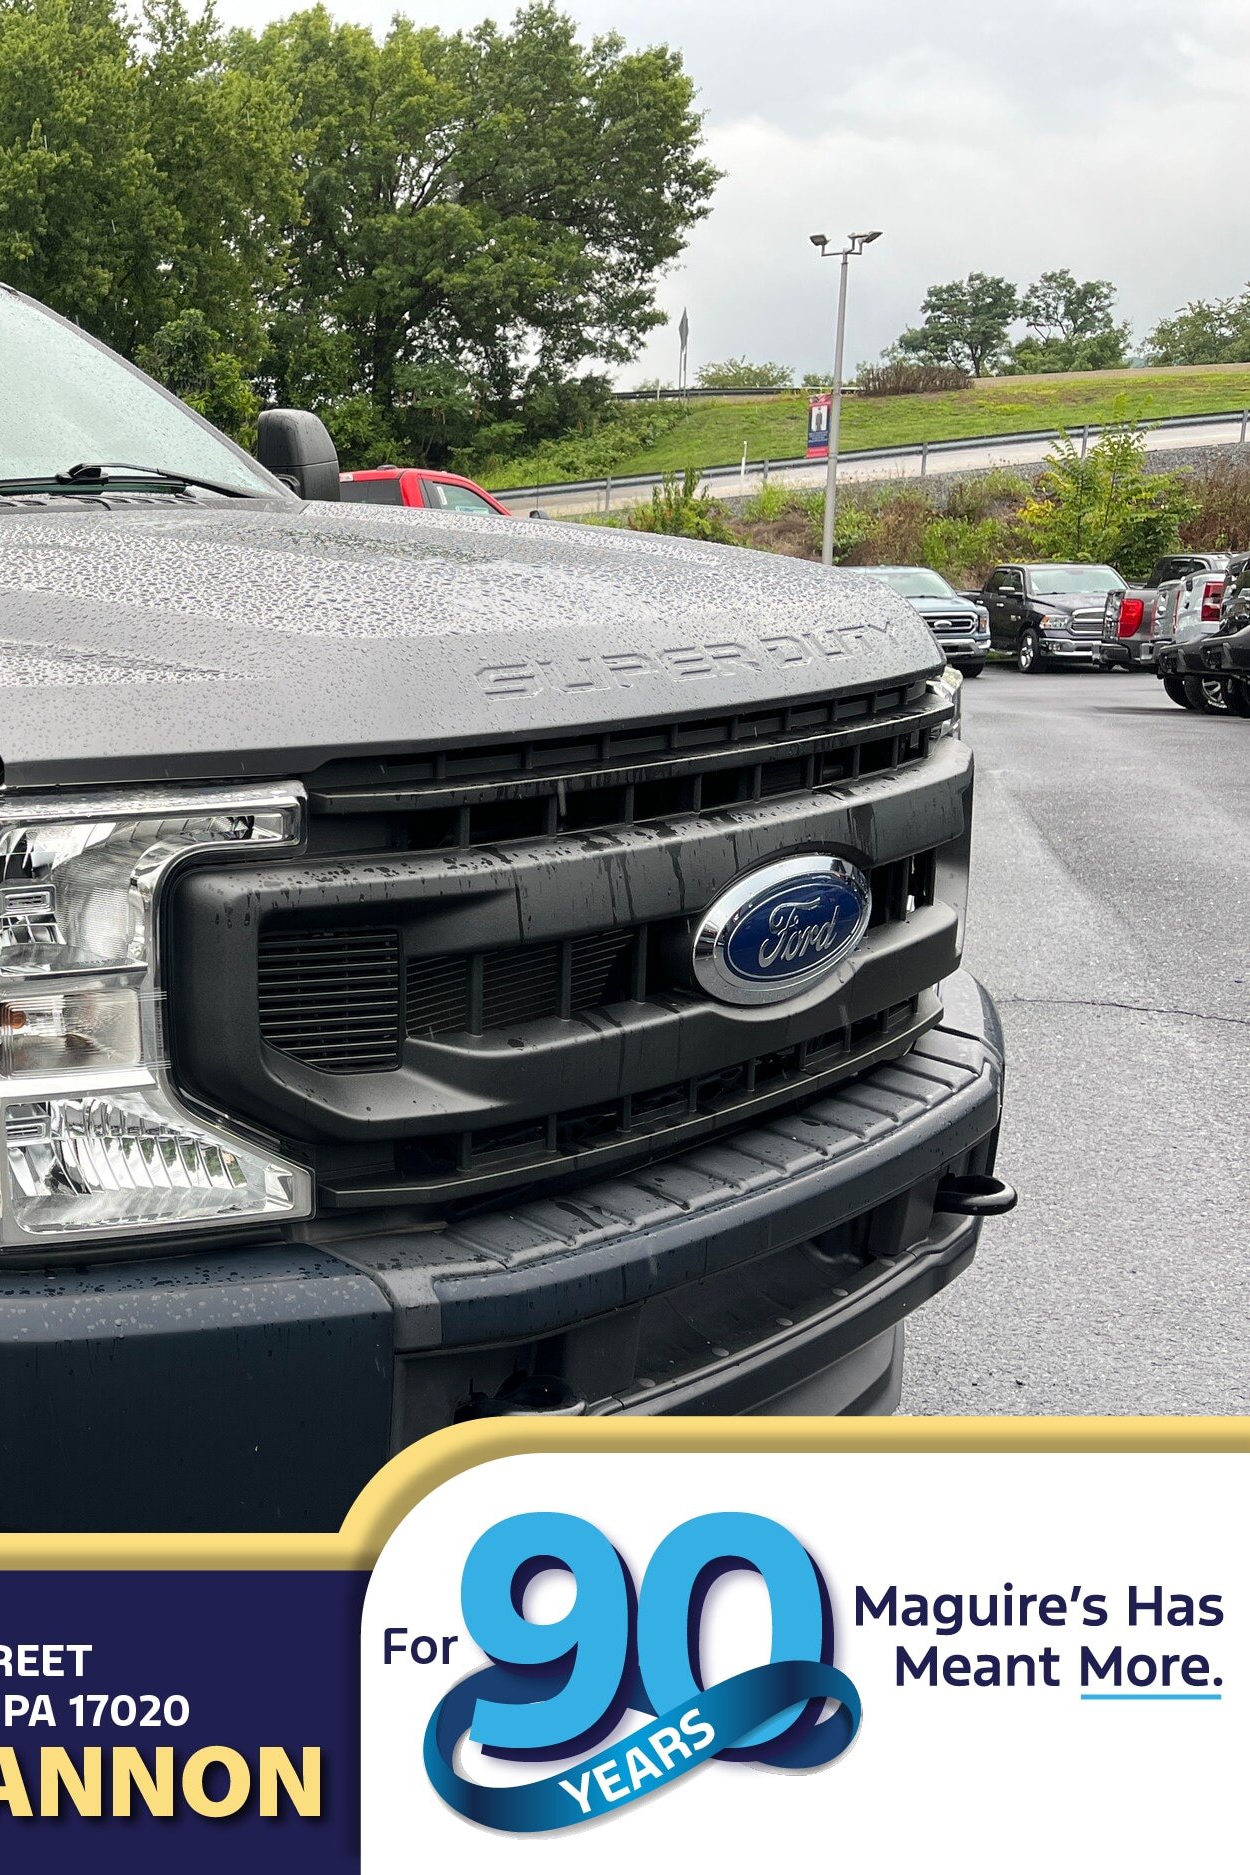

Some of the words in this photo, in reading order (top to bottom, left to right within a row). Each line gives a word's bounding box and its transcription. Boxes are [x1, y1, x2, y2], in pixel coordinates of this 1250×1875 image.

[473, 641, 762, 700] SUPER
[760, 620, 904, 669] DUTY
[758, 896, 841, 968] Ford
